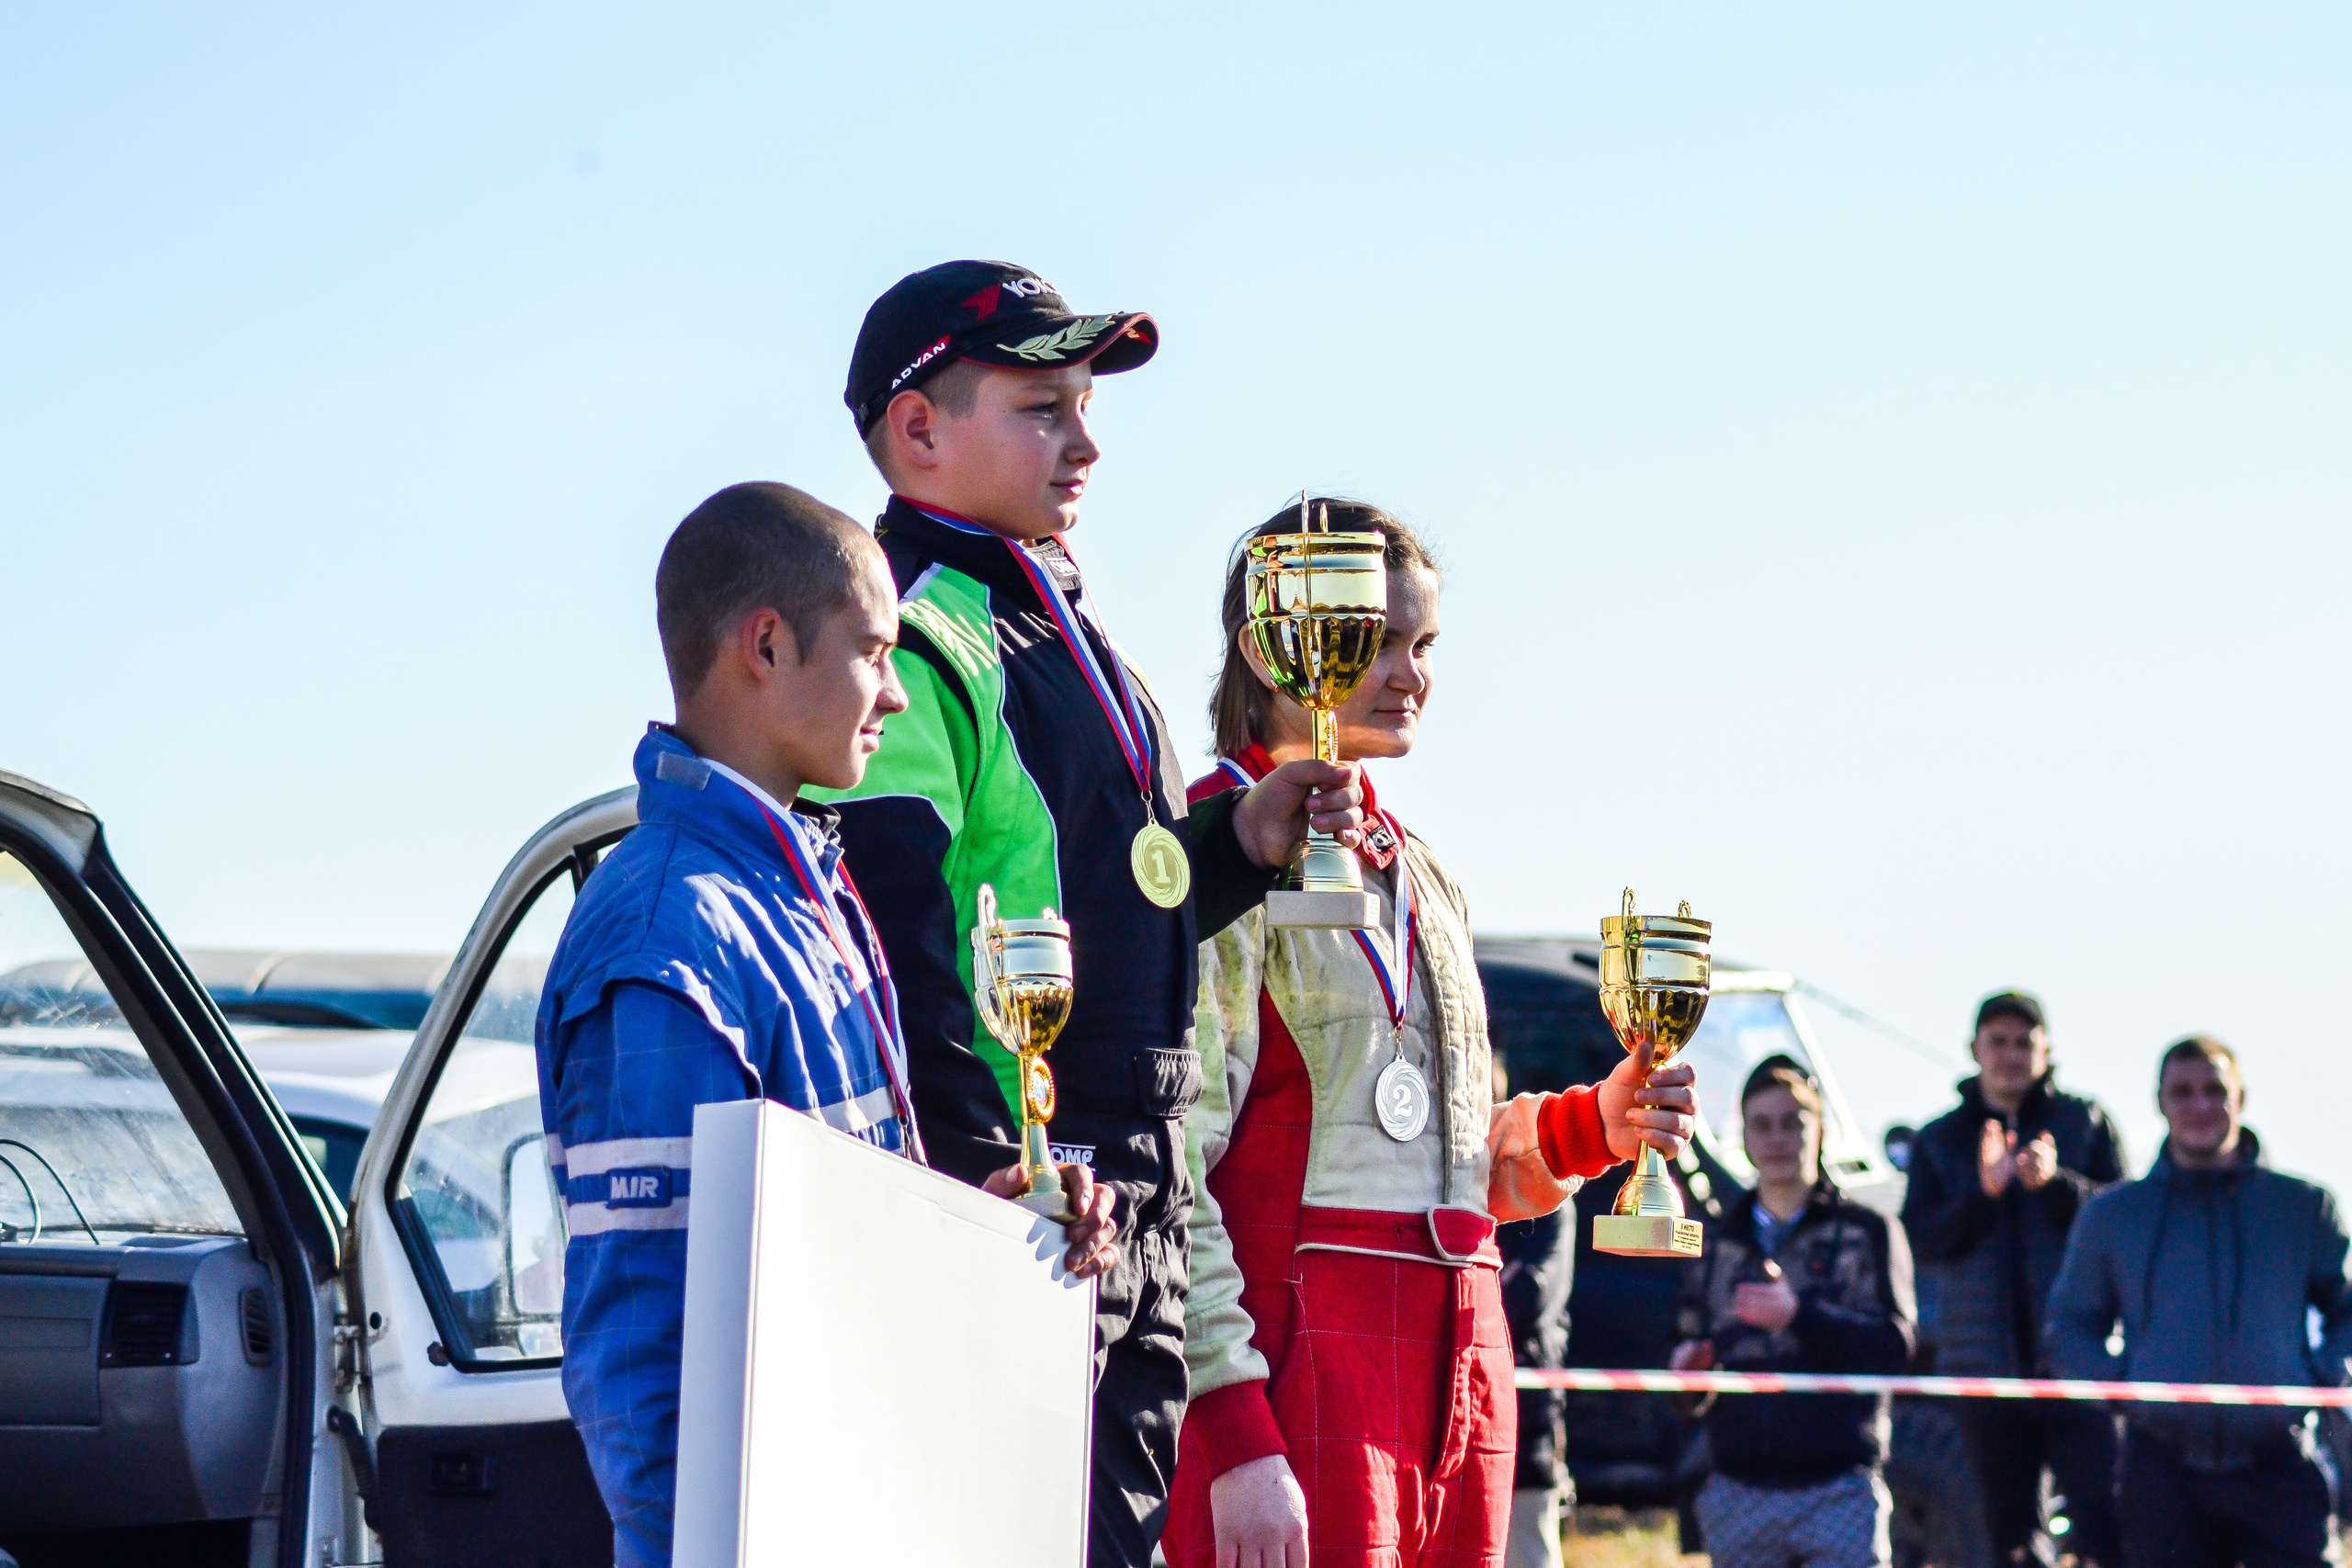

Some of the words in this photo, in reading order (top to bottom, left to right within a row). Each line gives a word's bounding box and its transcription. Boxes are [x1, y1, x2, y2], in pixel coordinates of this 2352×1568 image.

[1002, 278, 1062, 298] YOKO
[891, 342, 946, 390] ADVAN
[1151, 850, 1171, 884] 1
[1393, 1084, 1413, 1118] 2
[1049, 1146, 1093, 1165] OMP
